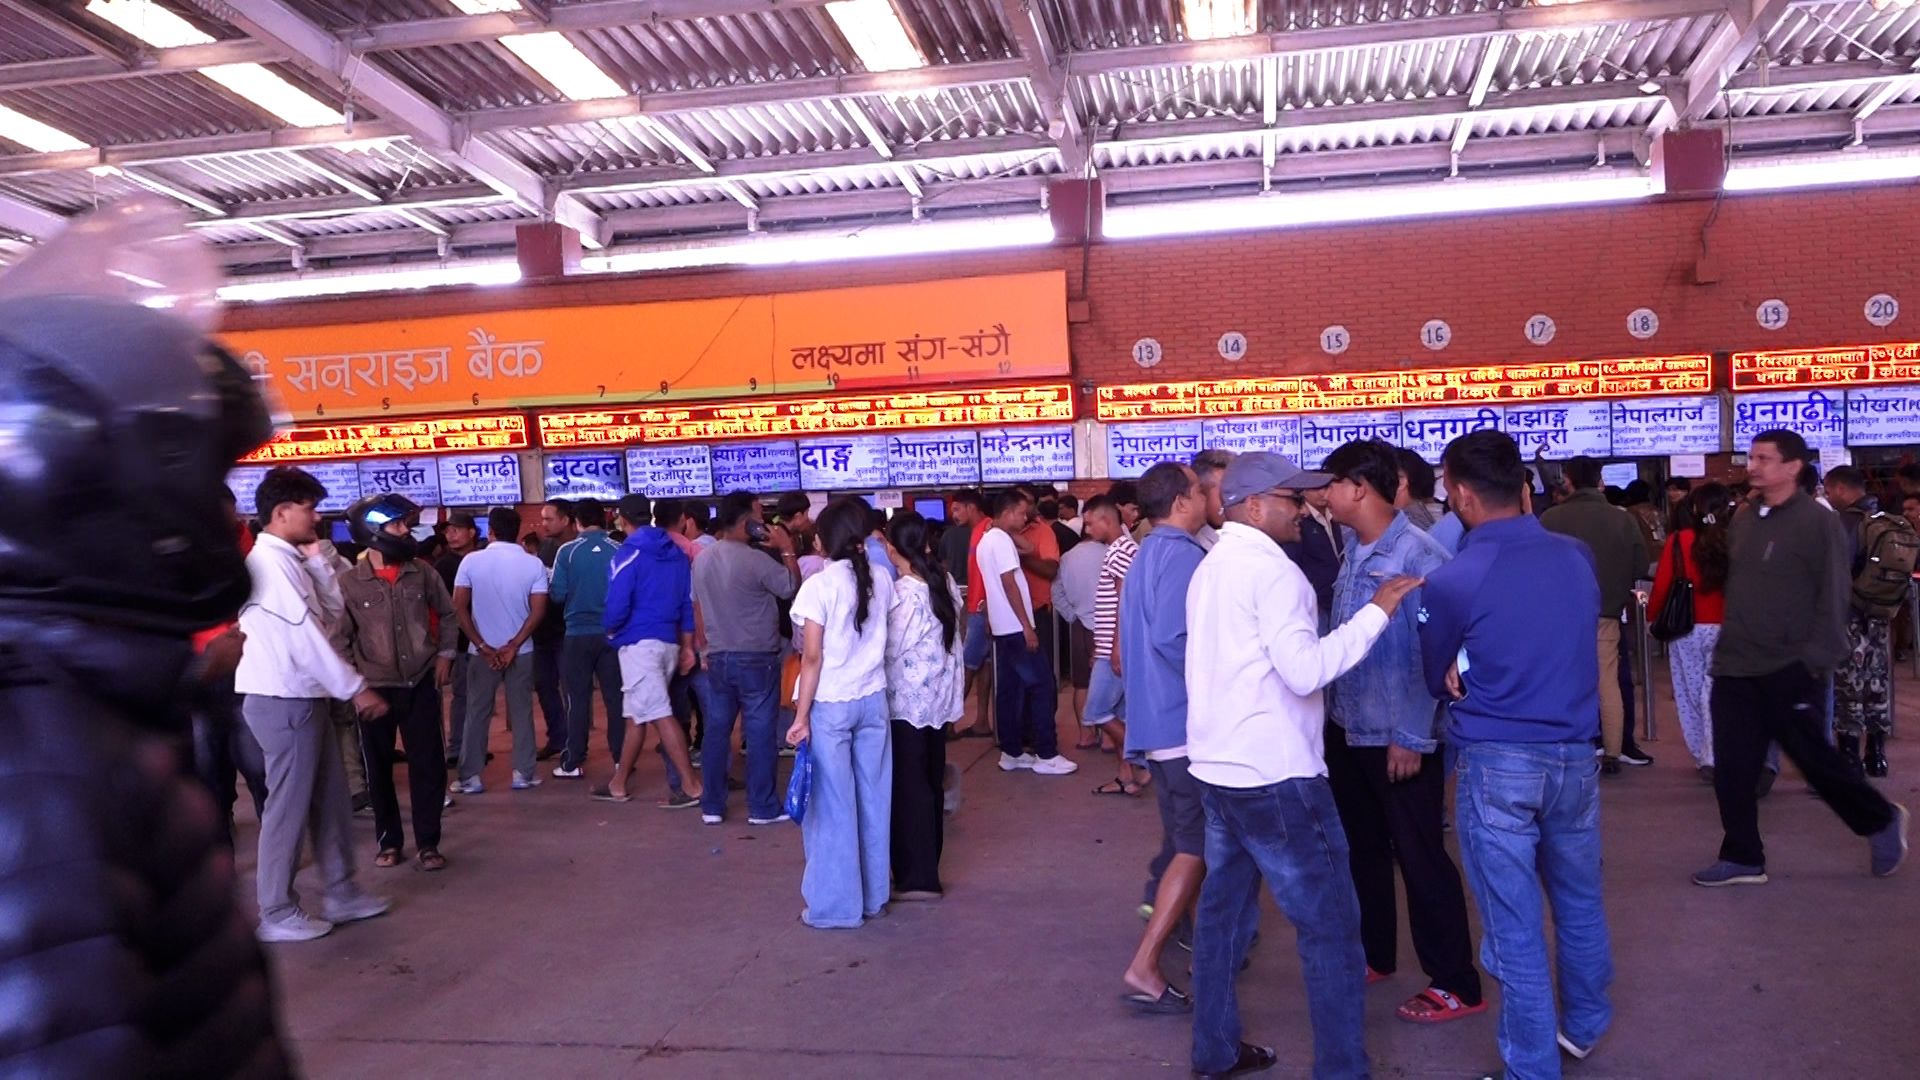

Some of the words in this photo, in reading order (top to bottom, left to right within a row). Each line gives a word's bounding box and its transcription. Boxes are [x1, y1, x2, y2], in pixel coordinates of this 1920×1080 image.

[1764, 307, 1781, 324] 19
[1871, 301, 1894, 318] 20
[1530, 322, 1545, 338] 17
[1632, 316, 1650, 332] 18
[896, 324, 1012, 363] संग-संगै
[1326, 334, 1343, 350] 15
[1426, 327, 1444, 344] 16
[466, 327, 545, 380] बैंक
[1137, 345, 1154, 362] 13
[1223, 339, 1240, 354] 14
[660, 381, 668, 395] 8
[749, 377, 757, 391] 9
[827, 373, 840, 386] 10
[471, 392, 480, 406] 6
[598, 385, 606, 397] 7
[382, 397, 391, 410] 5
[1736, 391, 1831, 421] धनगढी
[1850, 393, 1908, 414] पोखरा
[1613, 401, 1704, 424] नेपालगंज
[1216, 419, 1257, 434] पोखरा
[1303, 419, 1399, 443] नेपालगंज
[890, 435, 975, 458] नेपालगंज
[982, 431, 1071, 455] महेन्द्रनगर
[456, 455, 517, 478] धनगढी
[551, 456, 622, 486] बुटवल
[372, 460, 426, 492] सुर्खेत
